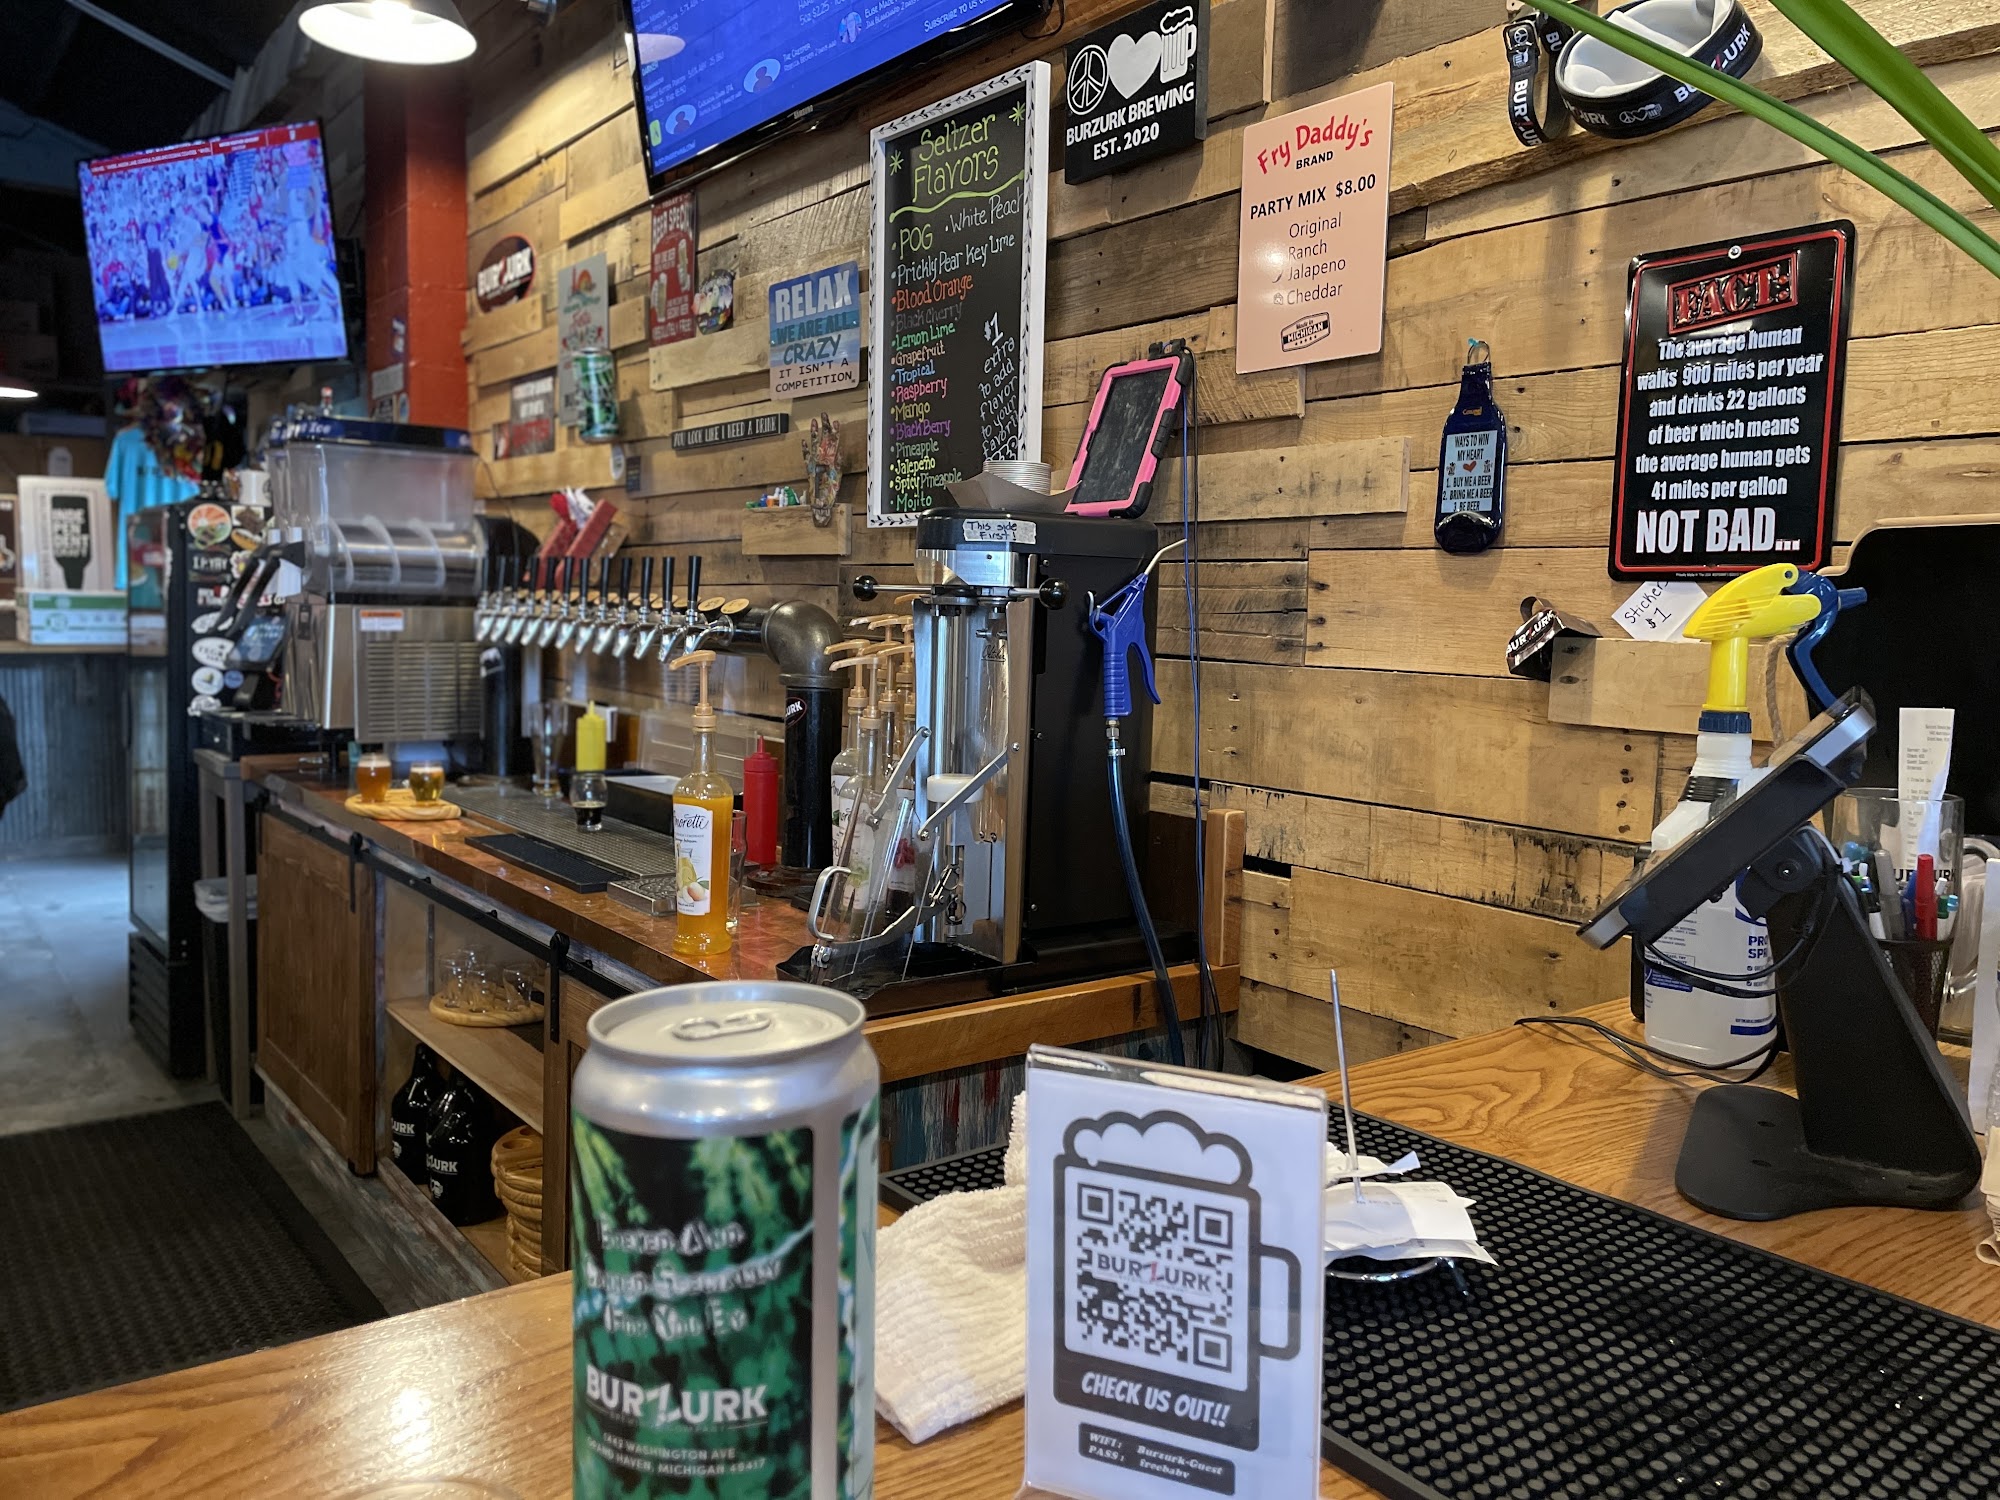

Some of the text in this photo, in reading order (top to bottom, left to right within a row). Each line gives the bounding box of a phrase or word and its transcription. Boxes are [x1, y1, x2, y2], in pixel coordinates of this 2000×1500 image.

[1066, 81, 1195, 146] BURZURK BREWING
[919, 113, 996, 162] Seltzer
[1093, 122, 1160, 161] EST. 2020
[1257, 114, 1374, 175] Fry Daddy's
[912, 145, 999, 203] Flavors
[1295, 150, 1334, 170] BRAND
[950, 186, 1024, 233] White Peach
[1250, 173, 1376, 220] PARTY MIX $8.00
[1289, 211, 1342, 239] Original
[899, 223, 934, 261] POG
[1288, 239, 1328, 262] Ranch
[897, 256, 938, 287] Prickly
[938, 250, 964, 276] Pear
[989, 233, 1016, 255] Lime
[1288, 258, 1346, 284] Jalapeno
[775, 270, 852, 323] RELAX
[896, 274, 974, 312] Blood Orange
[1286, 282, 1343, 306] Cheddar
[776, 311, 850, 345] WE ARE ALL
[896, 301, 963, 333] Black Cherry
[1288, 322, 1324, 342] MICHIGAN
[783, 334, 842, 366] CRAZY
[896, 321, 956, 351] Lemon Lime
[1658, 326, 1803, 361] The average human
[779, 358, 849, 379] IT ISN'T A
[895, 340, 946, 368] Grapefruit
[984, 336, 1015, 374] extra
[775, 371, 852, 393] COMPETITION
[895, 360, 936, 385] Tropical
[978, 358, 1015, 399] to add
[1637, 353, 1824, 391] walks 900 miles per year
[896, 377, 948, 403] Raspberry
[980, 375, 1018, 421] flavor
[1649, 385, 1807, 418] and drinks 22 gallons
[895, 401, 931, 423] Mango
[982, 394, 1016, 440] to your
[673, 432, 687, 447] YOU
[705, 425, 720, 442] LIKE
[721, 425, 725, 439] I
[727, 421, 745, 438] NEED
[747, 420, 753, 435] A
[755, 416, 777, 434] DRINK
[1455, 433, 1490, 448] WAYS TO WIN
[1648, 416, 1800, 445] of beer which means
[896, 438, 940, 459] Pineapple
[1457, 448, 1484, 462] MY HEART
[1635, 445, 1811, 475] the average human gets
[894, 468, 963, 494] Spicy Pineapple
[1442, 490, 1448, 501] 2.
[1449, 489, 1466, 500] BRING
[1466, 489, 1475, 500] ME
[1475, 488, 1479, 499] A
[1453, 477, 1464, 488] BUY
[1464, 476, 1472, 487] ME
[1472, 476, 1477, 487] A
[1477, 475, 1492, 486] BEER
[1651, 476, 1788, 500] 41 miles per gallon
[896, 495, 932, 512] Mojito
[1459, 501, 1467, 512] BE
[1466, 501, 1480, 512] BEER
[967, 520, 1018, 531] This side
[1635, 506, 1801, 554] NOT BAD...
[1645, 607, 1673, 630] $1
[1097, 1253, 1211, 1292] BURZURK
[586, 1363, 768, 1427] BURZURK
[1081, 1371, 1231, 1428] CHECK US OUT!!
[616, 1454, 654, 1473] HAVEN,
[658, 1463, 725, 1476] MICHIGAN
[626, 1441, 708, 1461] WASHINGTON
[710, 1448, 736, 1459] AVE
[1136, 1445, 1224, 1475] Burzurk-Guest
